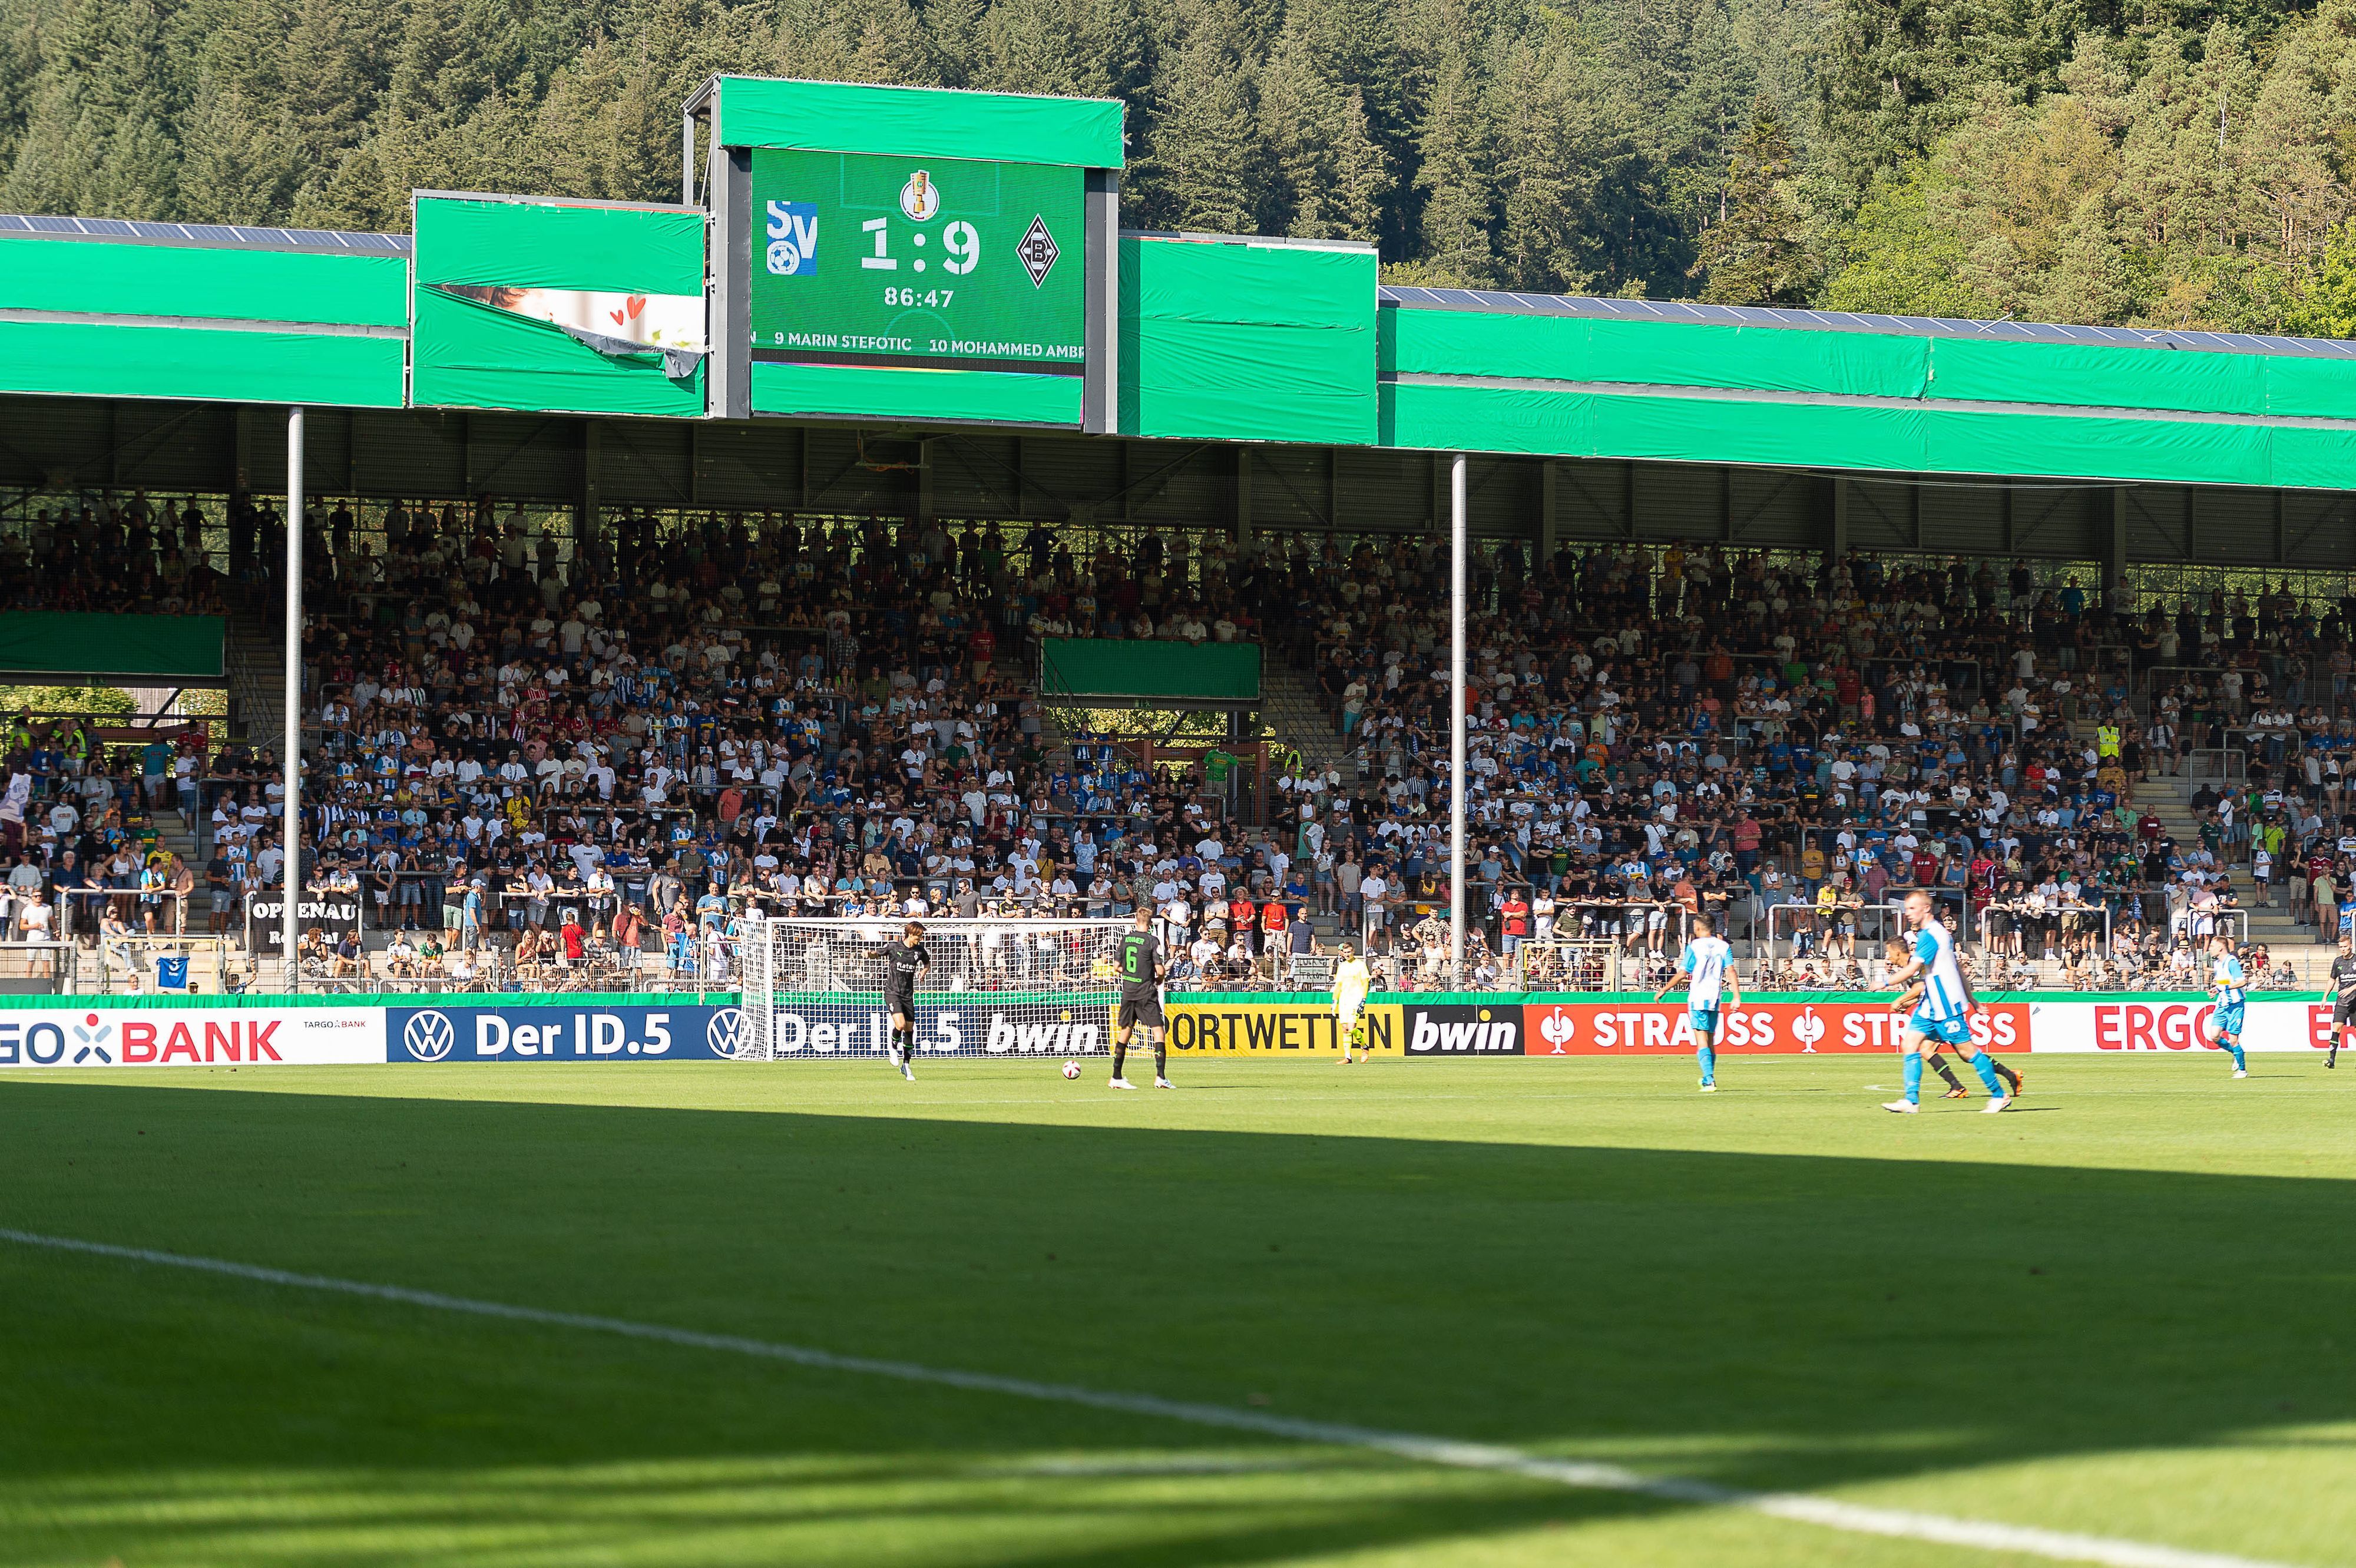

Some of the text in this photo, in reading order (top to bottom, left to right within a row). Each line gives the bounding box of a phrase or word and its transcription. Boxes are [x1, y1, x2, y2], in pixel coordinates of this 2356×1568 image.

[884, 286, 954, 308] 86:47
[775, 332, 784, 345] 9
[788, 332, 837, 347] MARIN
[842, 336, 912, 351] STEFOTIC
[929, 339, 948, 353] 10
[951, 340, 1043, 356] MOHAMMED
[1126, 945, 1138, 974] 6
[122, 1021, 283, 1063] BANK
[476, 1013, 671, 1055] Der ID.5
[776, 1013, 857, 1053] Der
[985, 1010, 1099, 1053] bwin
[1410, 1009, 1517, 1051] bwin
[1842, 1012, 2016, 1046] STRSS
